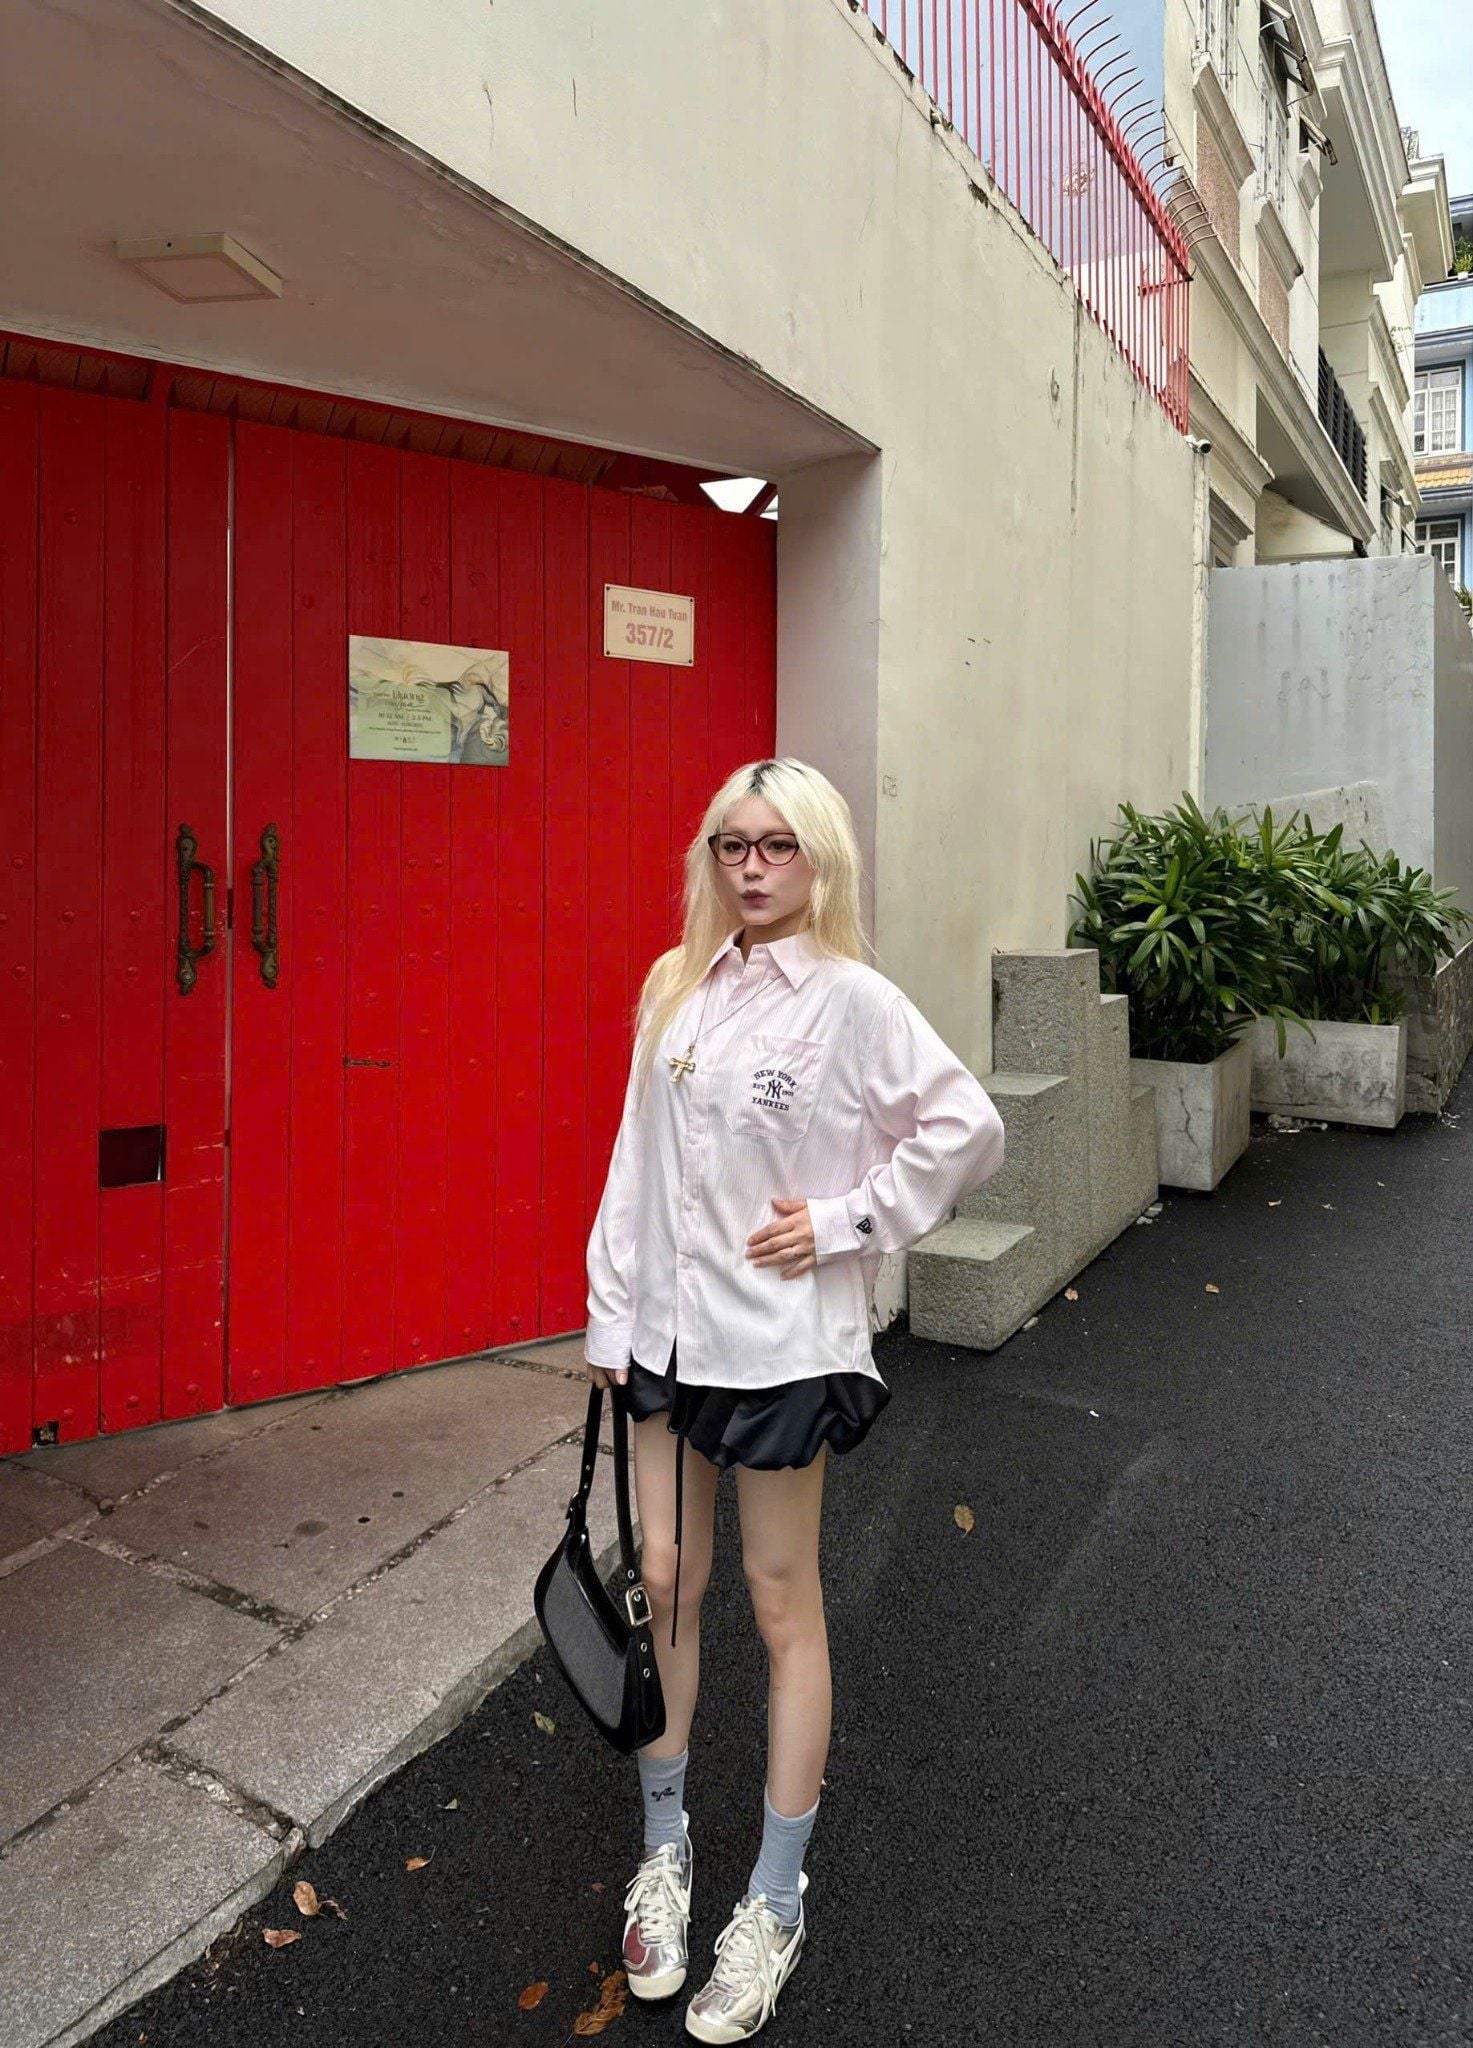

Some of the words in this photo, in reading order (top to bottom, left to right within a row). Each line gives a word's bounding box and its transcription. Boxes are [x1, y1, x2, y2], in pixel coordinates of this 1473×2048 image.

[611, 600, 625, 613] Mr.
[628, 603, 647, 617] Tran
[650, 605, 667, 619] Hau
[669, 609, 688, 621] Tuan
[625, 622, 674, 649] 357/2
[754, 1069, 775, 1080] NEW
[777, 1071, 797, 1089] YORK
[752, 1096, 789, 1111] YANKEES
